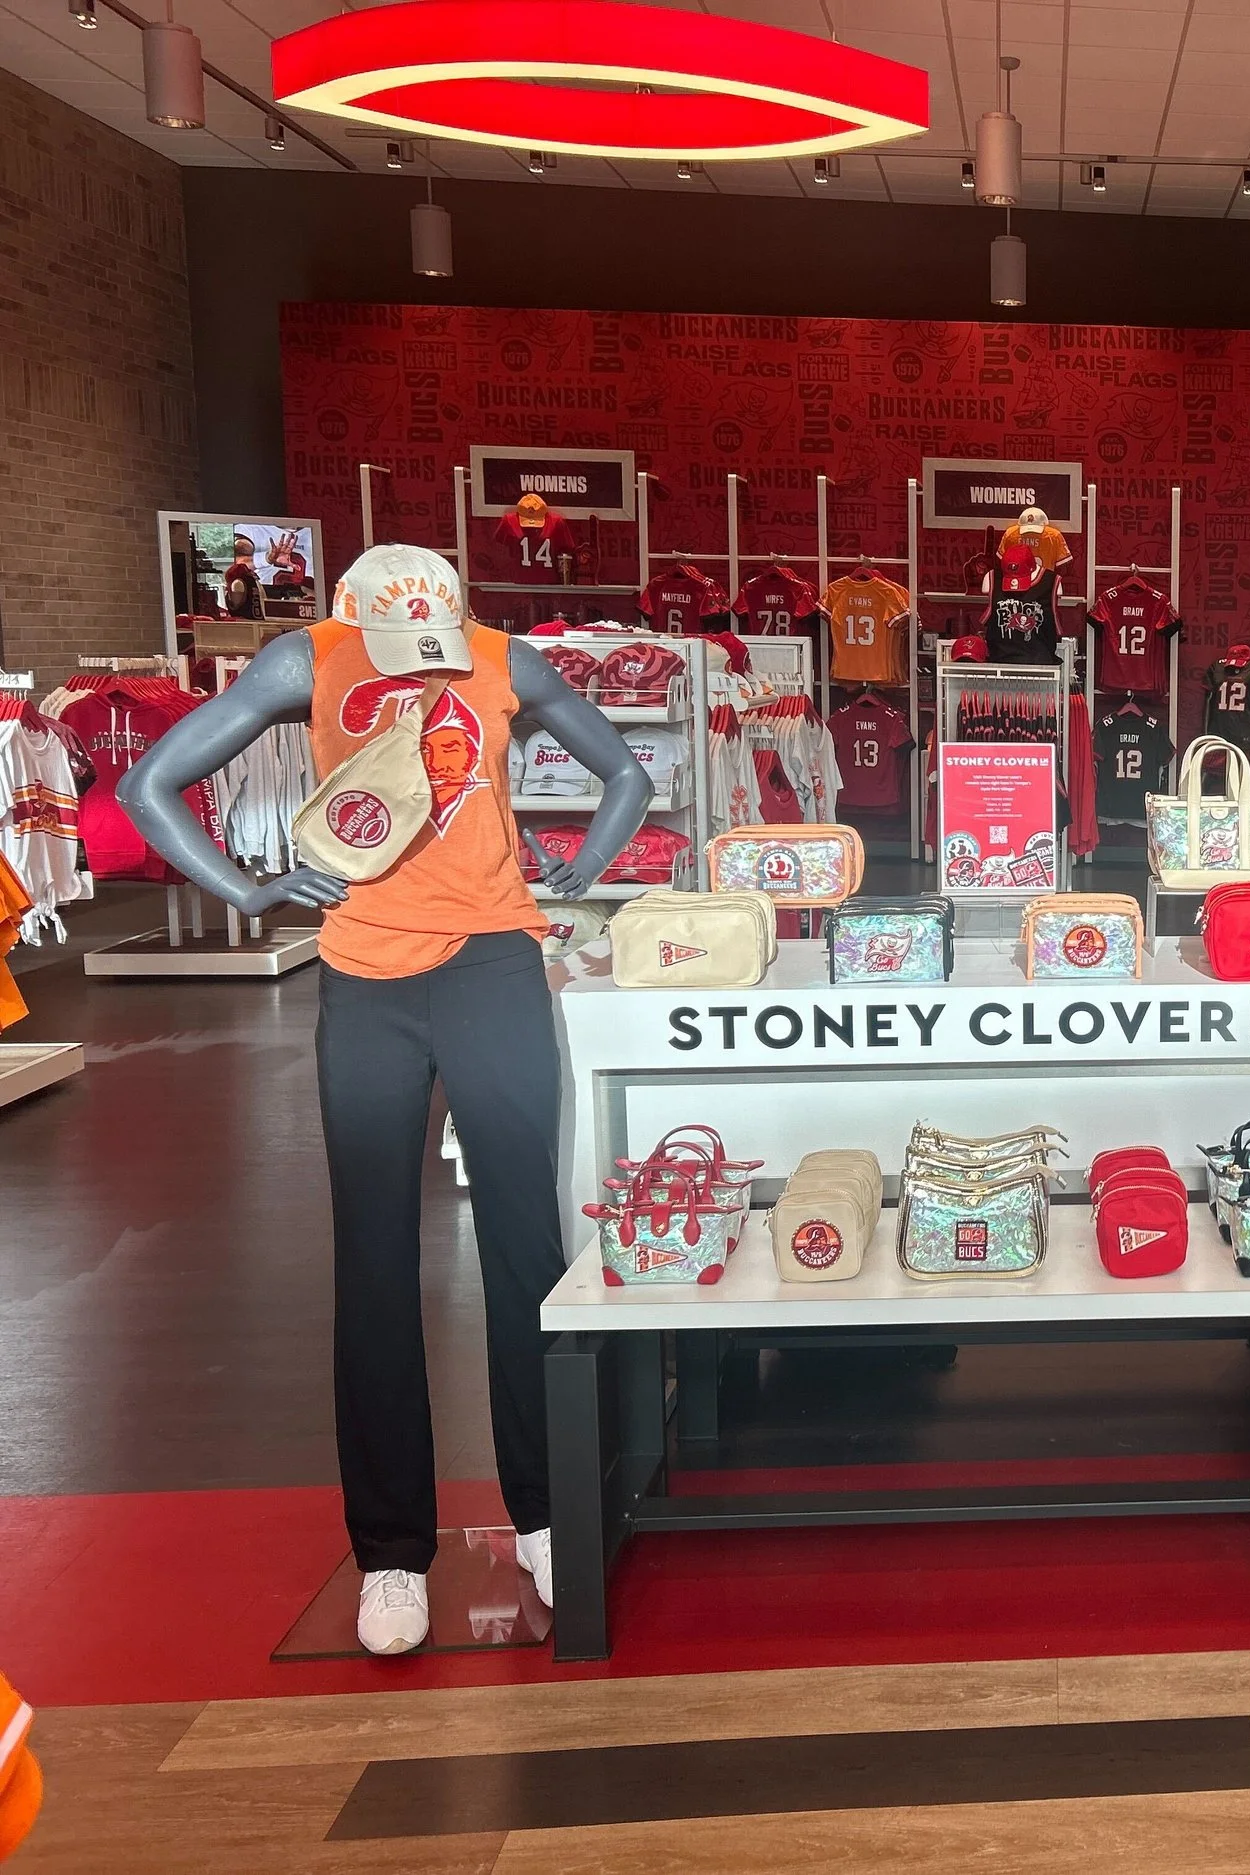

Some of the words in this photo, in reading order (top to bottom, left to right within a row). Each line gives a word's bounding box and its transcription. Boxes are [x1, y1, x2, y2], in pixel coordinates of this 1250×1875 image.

[659, 315, 798, 343] BUCCANEERS
[589, 311, 624, 372] BUC
[1049, 326, 1185, 353] BUCCANEERS
[406, 352, 456, 369] KREWE
[667, 344, 740, 360] RAISE
[979, 324, 1014, 385] BUC
[713, 362, 792, 377] FLAGS
[800, 363, 848, 381] KREWE
[895, 363, 920, 376] 1976
[1055, 355, 1126, 371] RAISE
[1100, 372, 1177, 388] FLAGS
[1184, 373, 1232, 391] KREWE
[477, 381, 617, 412] BUCCANEERS
[405, 372, 443, 443] BUCS
[869, 392, 1006, 423] BUCCANEERS
[485, 413, 557, 429] RAISE
[798, 383, 834, 453] BUCS
[876, 424, 946, 440] RAISE
[1182, 394, 1216, 464] BUCS
[531, 430, 611, 447] FLAGS
[715, 432, 741, 446] 1976
[920, 442, 997, 458] FLAGS
[1101, 442, 1125, 456] 1976
[519, 474, 588, 494] WOMENS
[970, 486, 1036, 506] WOMENS
[1099, 505, 1149, 520] AISE
[1123, 521, 1199, 537] FLAS
[519, 536, 553, 568] 14
[1204, 543, 1238, 610] BUCS
[335, 579, 357, 619] 76
[371, 577, 430, 617] TAMPA
[435, 582, 460, 614] BAY
[661, 592, 692, 604] MAYFIELD
[765, 595, 784, 605] WIRFS
[849, 596, 872, 607] EVANS
[1123, 606, 1144, 617] BRADY
[667, 609, 683, 634] 6
[757, 610, 791, 636] 78
[845, 615, 875, 646] 13
[1118, 626, 1146, 655] 12
[1218, 681, 1247, 712] 12
[856, 720, 877, 732] EVANS
[1119, 734, 1140, 744] BRADY
[534, 750, 570, 766] Bucs
[853, 740, 879, 767] 13
[946, 757, 991, 766] STONEY
[993, 757, 1038, 767] CLOVER
[1116, 750, 1142, 779] 12
[201, 778, 216, 811] MPA
[210, 815, 225, 842] BAY
[340, 798, 380, 840] BUCCANEERS
[668, 1003, 946, 1050] STONEY
[969, 1001, 1237, 1046] CLOVER
[959, 1230, 971, 1240] GO
[797, 1246, 838, 1265] BUCCANEERS
[958, 1246, 984, 1258] BUCS
